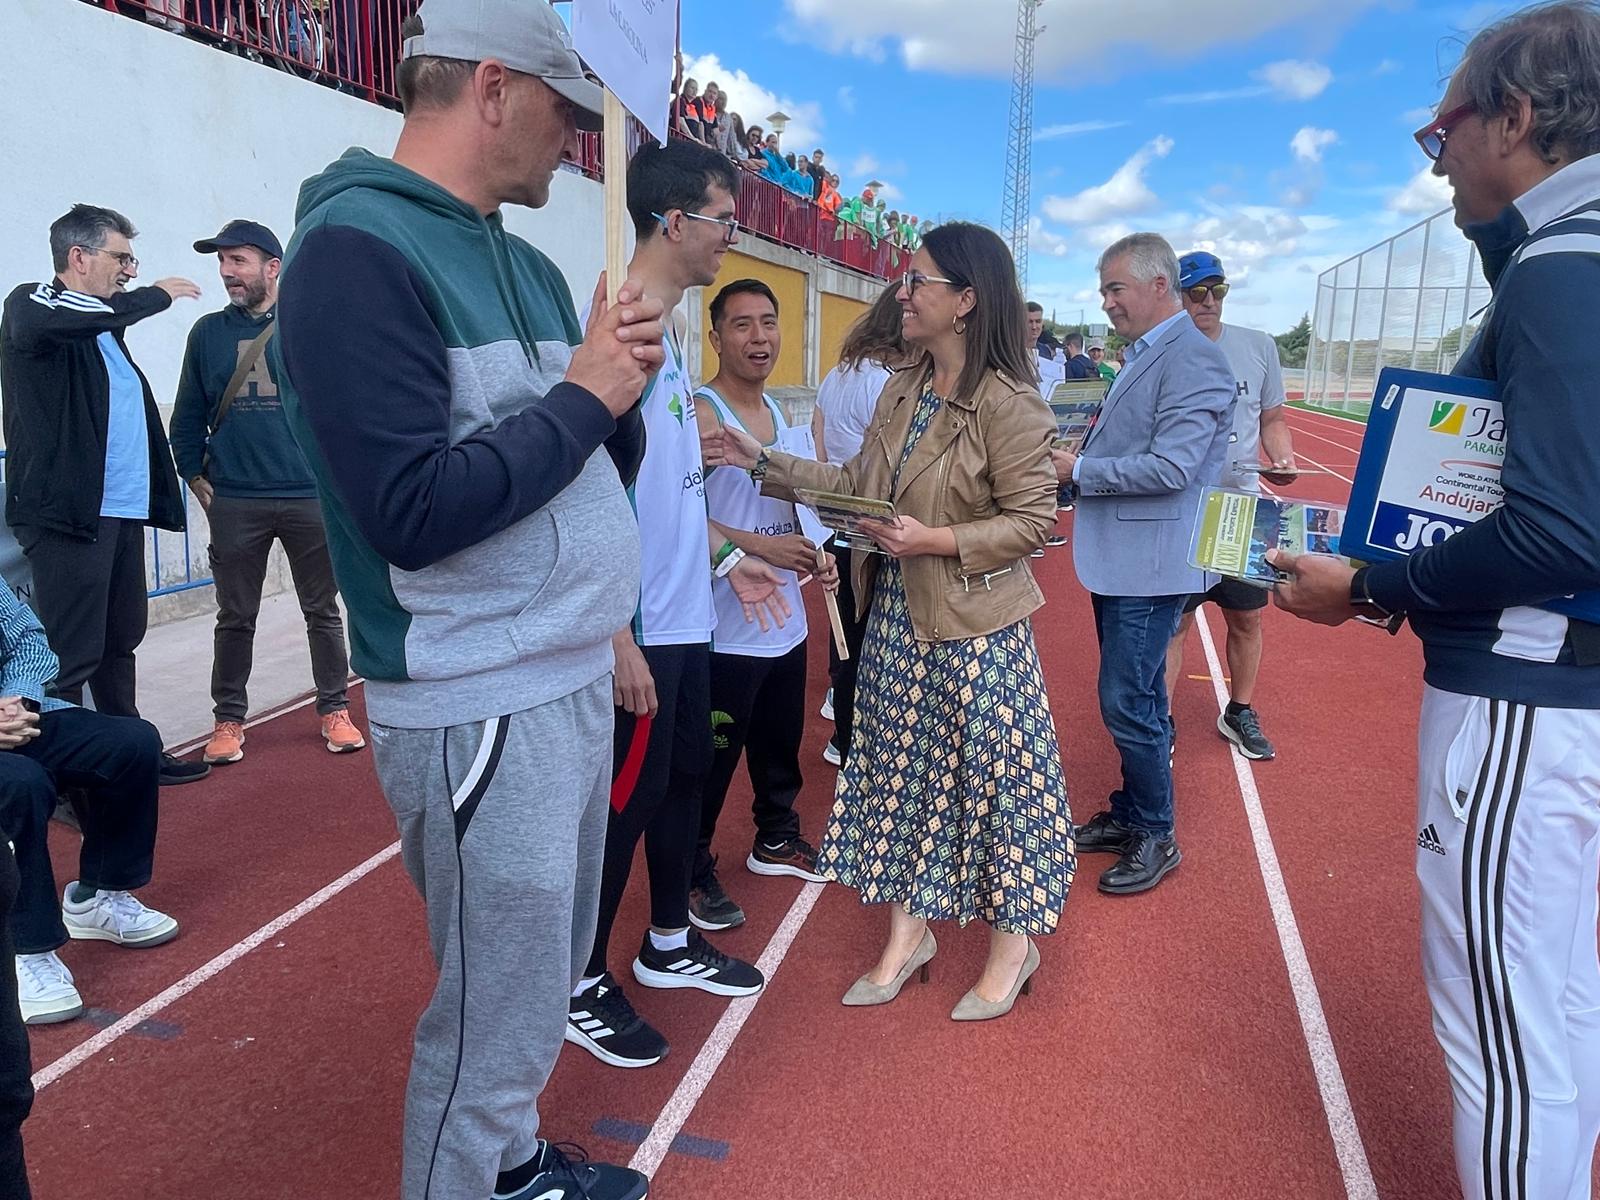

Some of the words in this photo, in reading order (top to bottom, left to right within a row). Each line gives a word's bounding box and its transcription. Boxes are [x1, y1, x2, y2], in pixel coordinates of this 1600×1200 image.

[1466, 407, 1506, 442] Ja
[1464, 440, 1505, 457] PARAÍS
[1435, 475, 1486, 492] Continental
[1486, 485, 1505, 497] Tour
[1458, 472, 1483, 482] WORLD
[1483, 476, 1501, 486] ATHL
[1419, 485, 1495, 514] Andújar
[1395, 513, 1465, 550] JO
